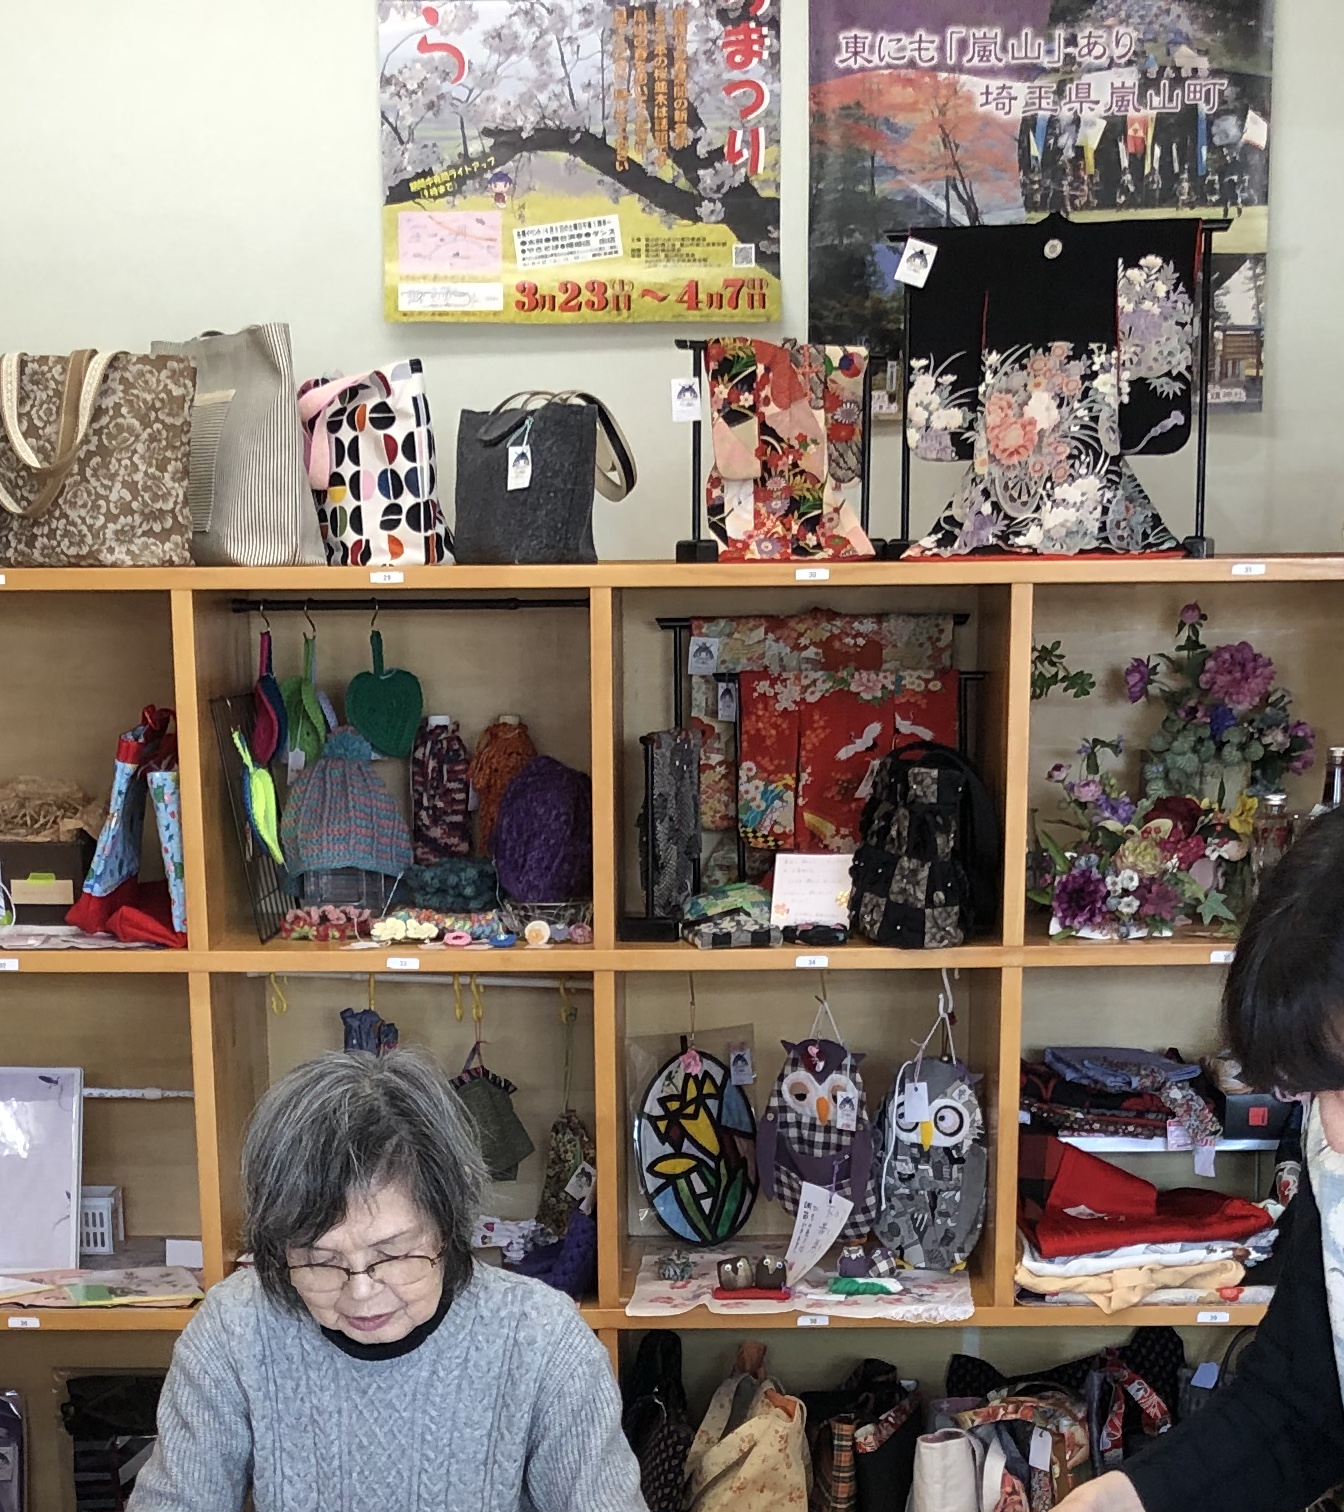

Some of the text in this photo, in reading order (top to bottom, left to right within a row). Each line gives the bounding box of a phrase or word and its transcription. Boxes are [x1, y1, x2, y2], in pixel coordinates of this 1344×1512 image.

[837, 27, 1137, 66] 東にも「嵐山」あり
[720, 0, 772, 174] まつり
[979, 78, 1227, 115] 埼玉県嵐山町
